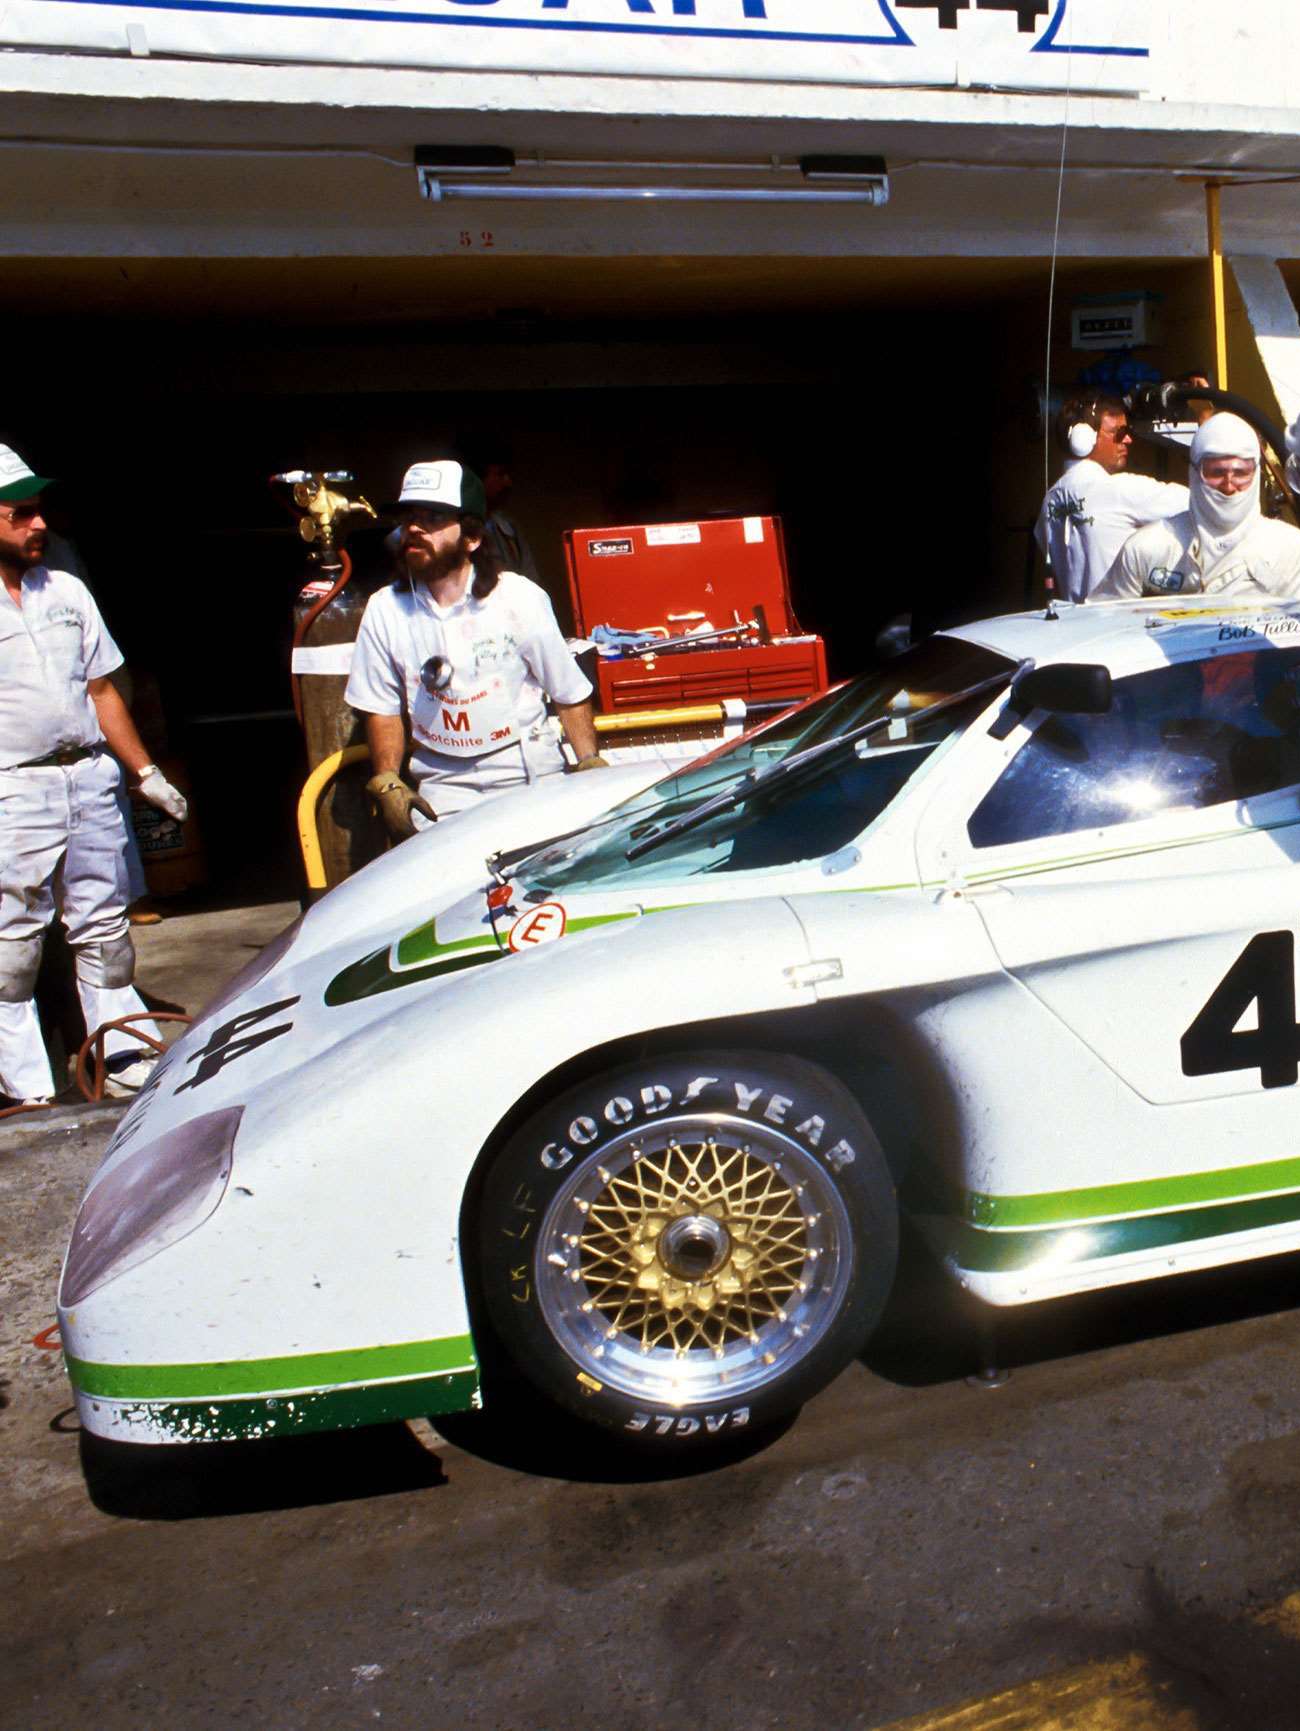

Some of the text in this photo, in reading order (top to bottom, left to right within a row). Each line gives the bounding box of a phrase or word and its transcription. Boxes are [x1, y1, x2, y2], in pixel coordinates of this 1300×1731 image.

[442, 708, 471, 732] M
[490, 725, 512, 742] 3M
[521, 912, 554, 944] E
[623, 1406, 752, 1437] EAGLE
